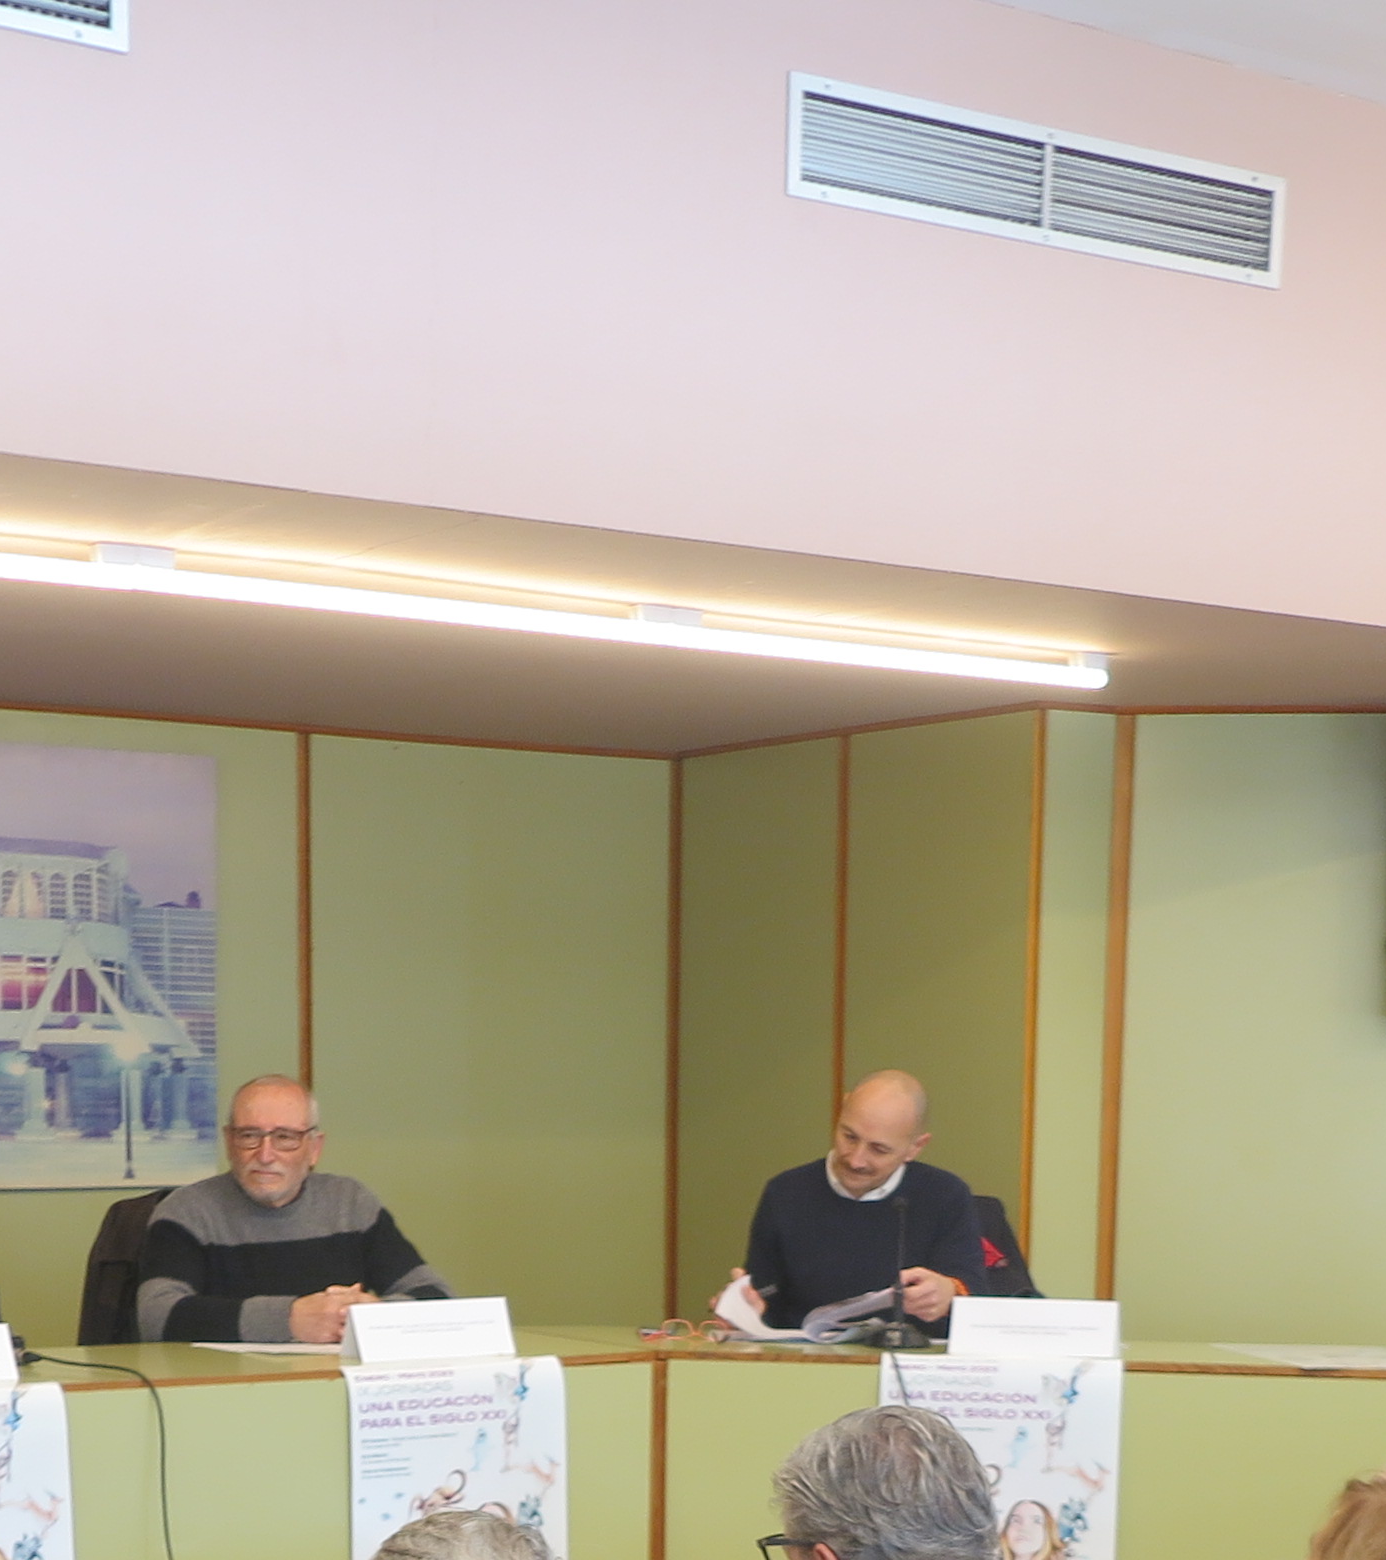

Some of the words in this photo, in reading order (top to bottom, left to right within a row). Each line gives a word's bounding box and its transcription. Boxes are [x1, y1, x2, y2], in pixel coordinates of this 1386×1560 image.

[359, 1402, 393, 1413] UNA
[360, 1418, 402, 1428] PARA
[406, 1415, 425, 1426] EL
[429, 1411, 477, 1424] SIGLO
